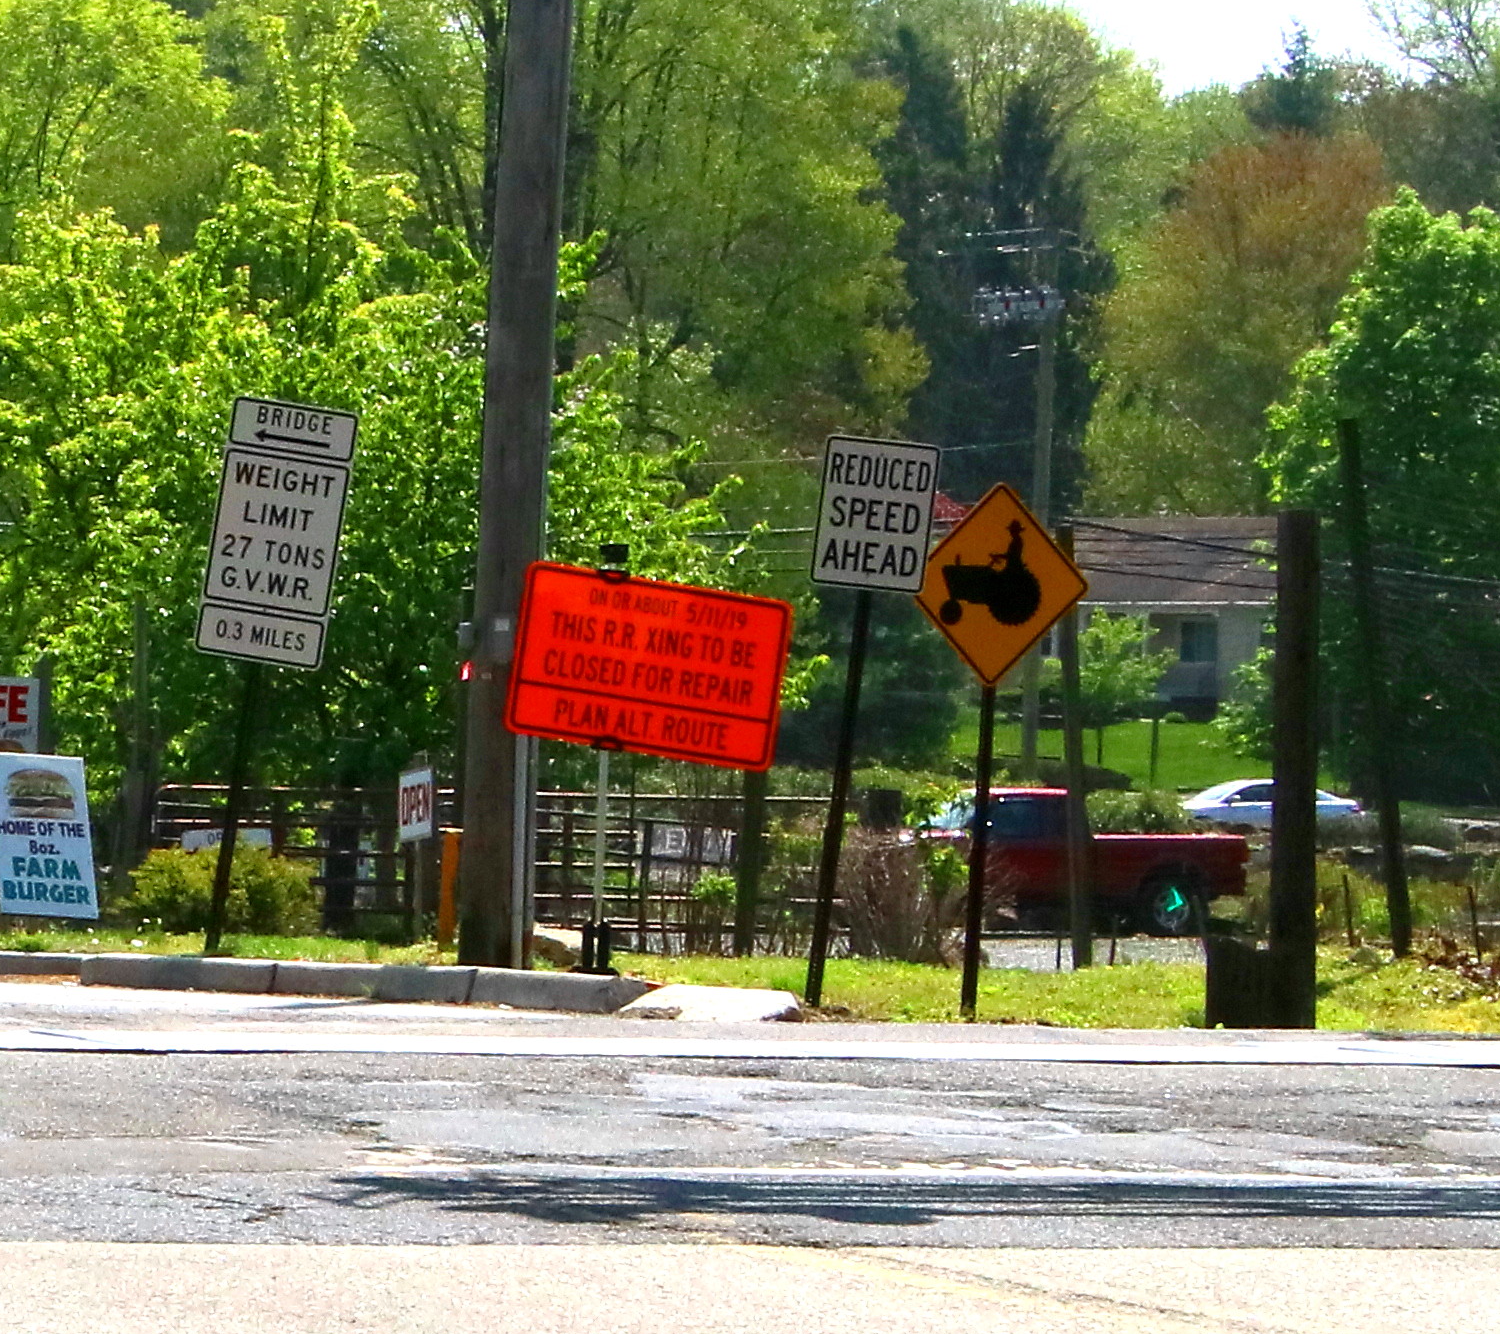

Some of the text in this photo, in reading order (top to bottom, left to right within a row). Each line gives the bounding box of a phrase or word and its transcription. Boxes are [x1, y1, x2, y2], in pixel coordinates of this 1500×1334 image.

[257, 405, 333, 436] BRIDGE
[235, 461, 336, 499] WEIGHT
[830, 452, 932, 493] REDUCED
[243, 500, 315, 533] LIMIT
[830, 496, 921, 535] SPEED
[221, 534, 326, 570] 27 TONS
[821, 538, 918, 578] AHEAD
[220, 566, 313, 602] G.V.W.R.
[590, 587, 609, 606] ON
[613, 591, 631, 611] OR
[635, 594, 680, 617] ABOUT
[216, 620, 306, 652] 0.3 MILES
[552, 611, 758, 670] THIS R.R. XING TO BE
[543, 649, 754, 707] CLOSED FOR REPAIR
[553, 698, 730, 751] PLAN ALT. ROUTE
[401, 780, 432, 825] OPEN
[37, 821, 55, 837] OF
[57, 822, 85, 838] THE
[12, 856, 82, 881] FARM
[2, 880, 91, 905] BURGER
